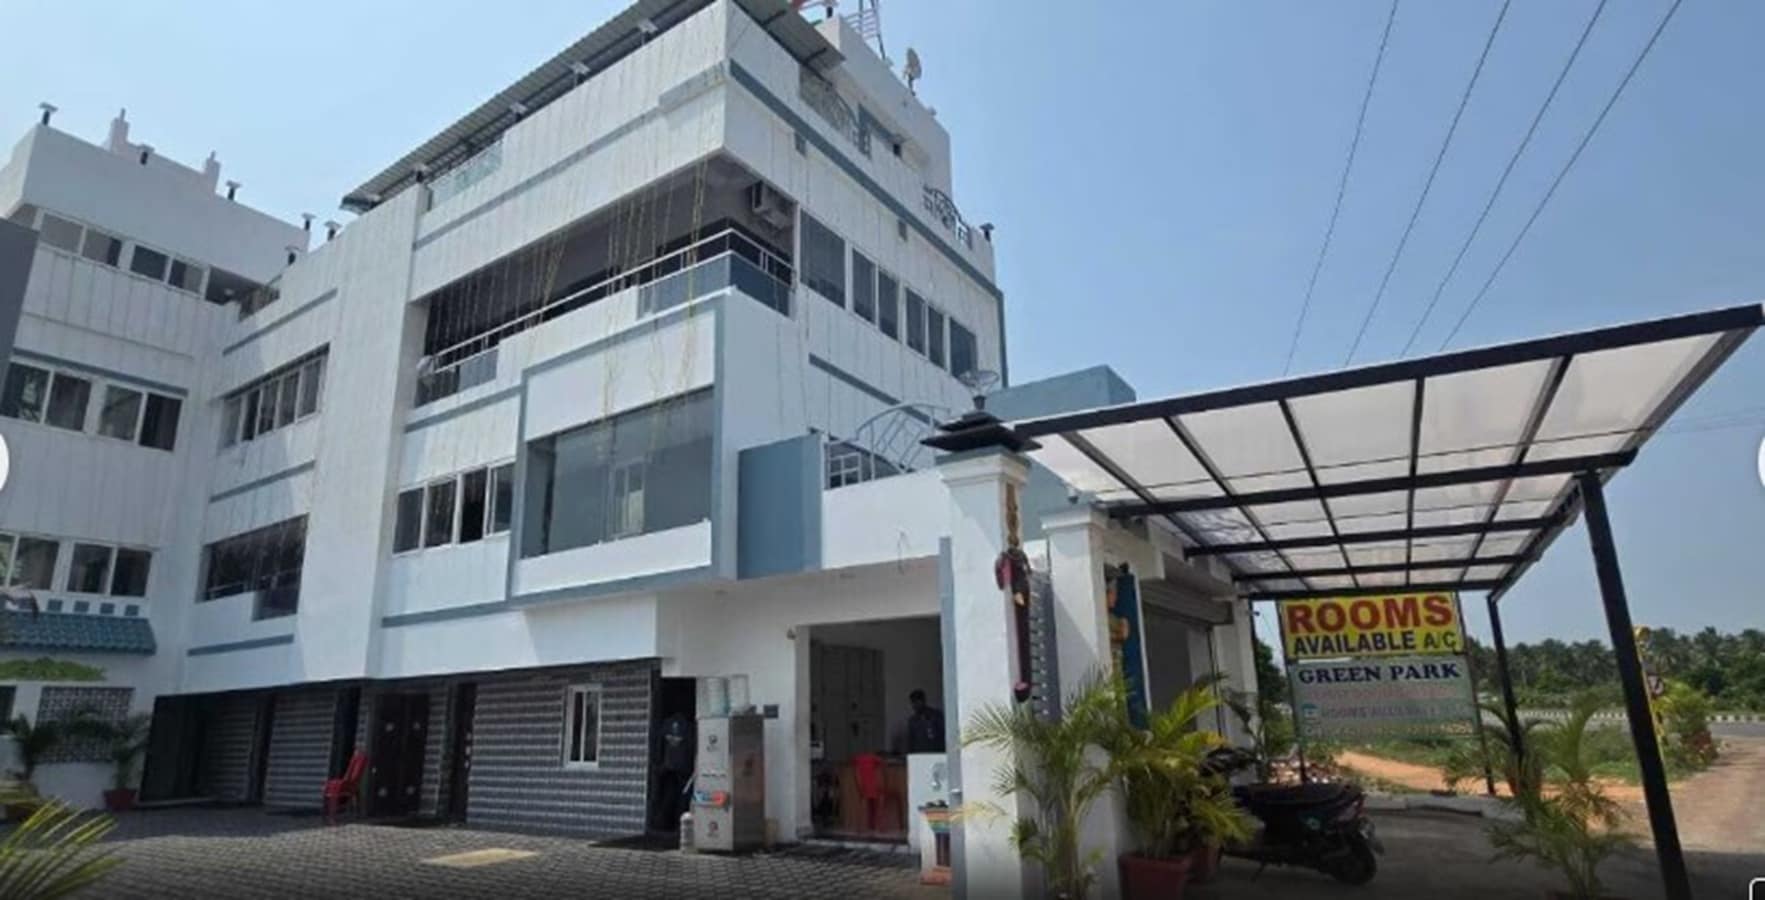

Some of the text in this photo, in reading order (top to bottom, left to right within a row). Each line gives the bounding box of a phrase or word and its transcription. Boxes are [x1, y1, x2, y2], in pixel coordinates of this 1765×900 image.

[1286, 595, 1452, 633] ROOMS
[1294, 632, 1416, 655] AVAILABLE
[1299, 663, 1460, 684] GREEN PARK
